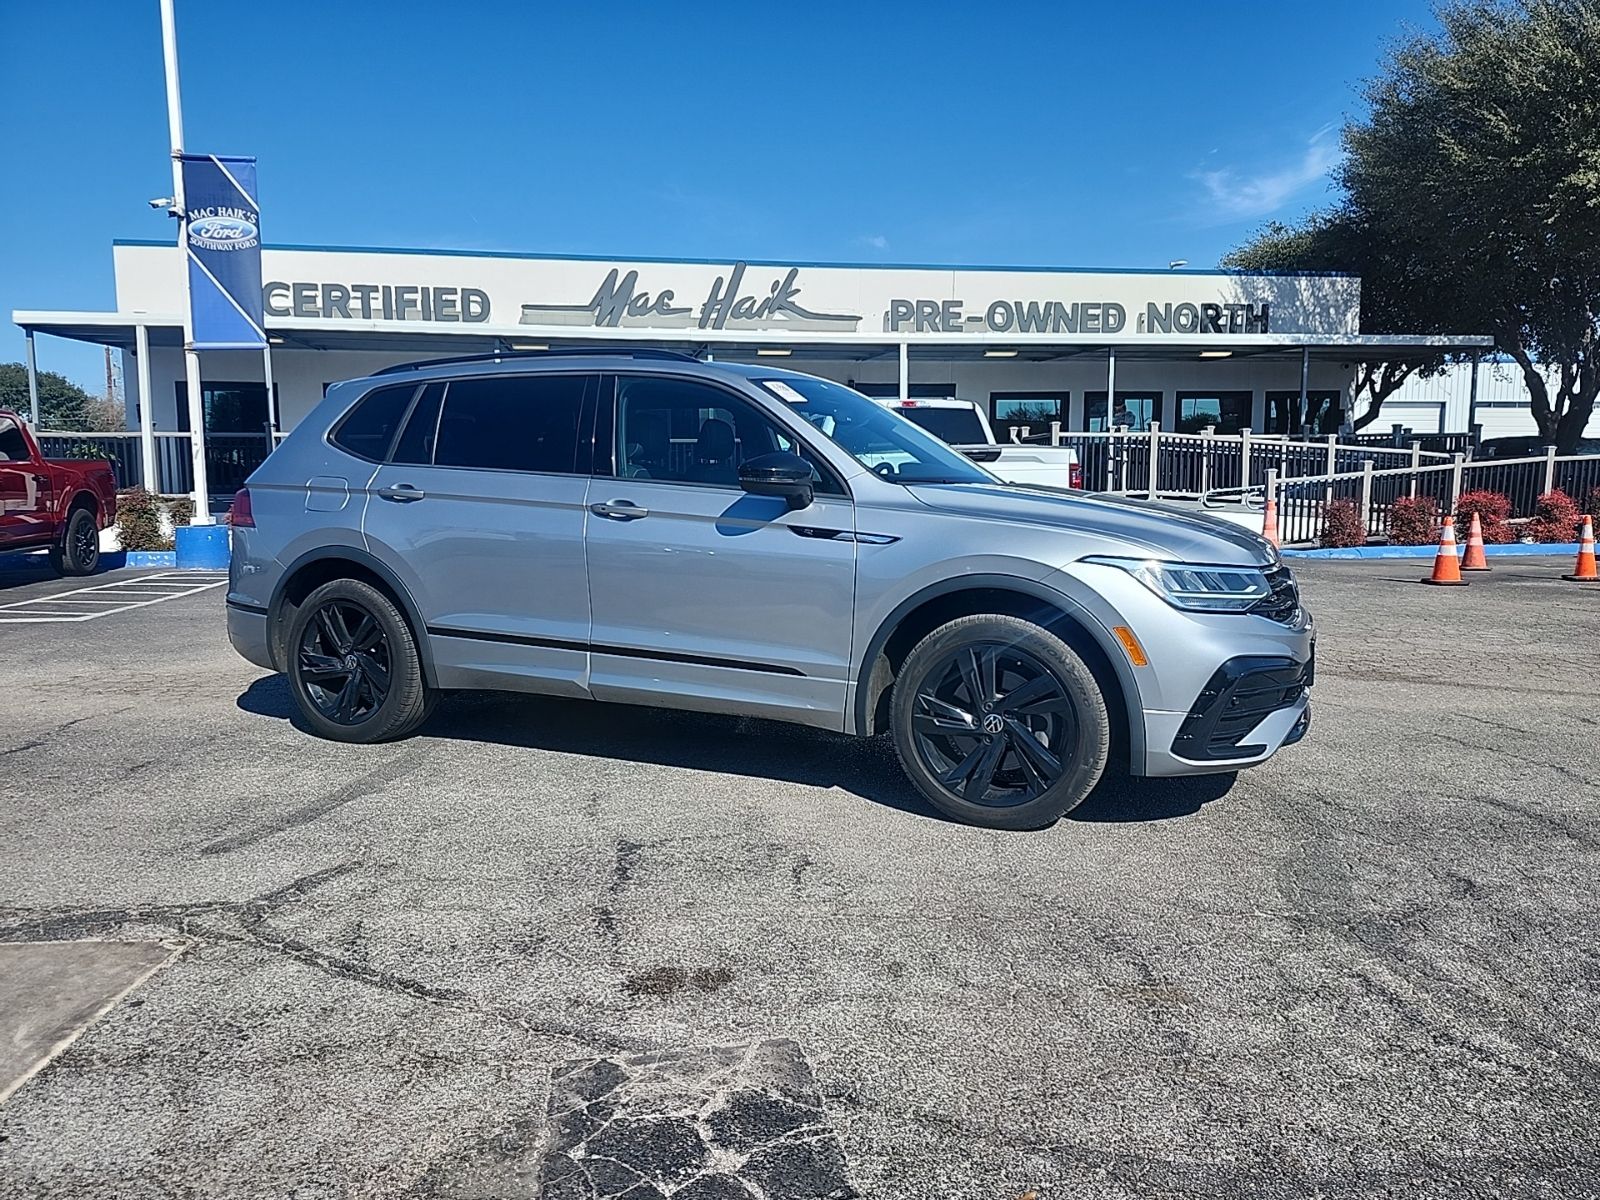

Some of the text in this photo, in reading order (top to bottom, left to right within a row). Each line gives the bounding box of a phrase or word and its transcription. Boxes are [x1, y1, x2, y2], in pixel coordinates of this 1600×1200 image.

[188, 206, 257, 223] MAC HAIK'S
[201, 221, 244, 238] Ford
[189, 237, 258, 251] SOUTHWAY FORD
[263, 281, 491, 323] CERTIFIED
[586, 260, 805, 330] Mac Haik
[890, 299, 1270, 334] PRE-OWNED NORTH
